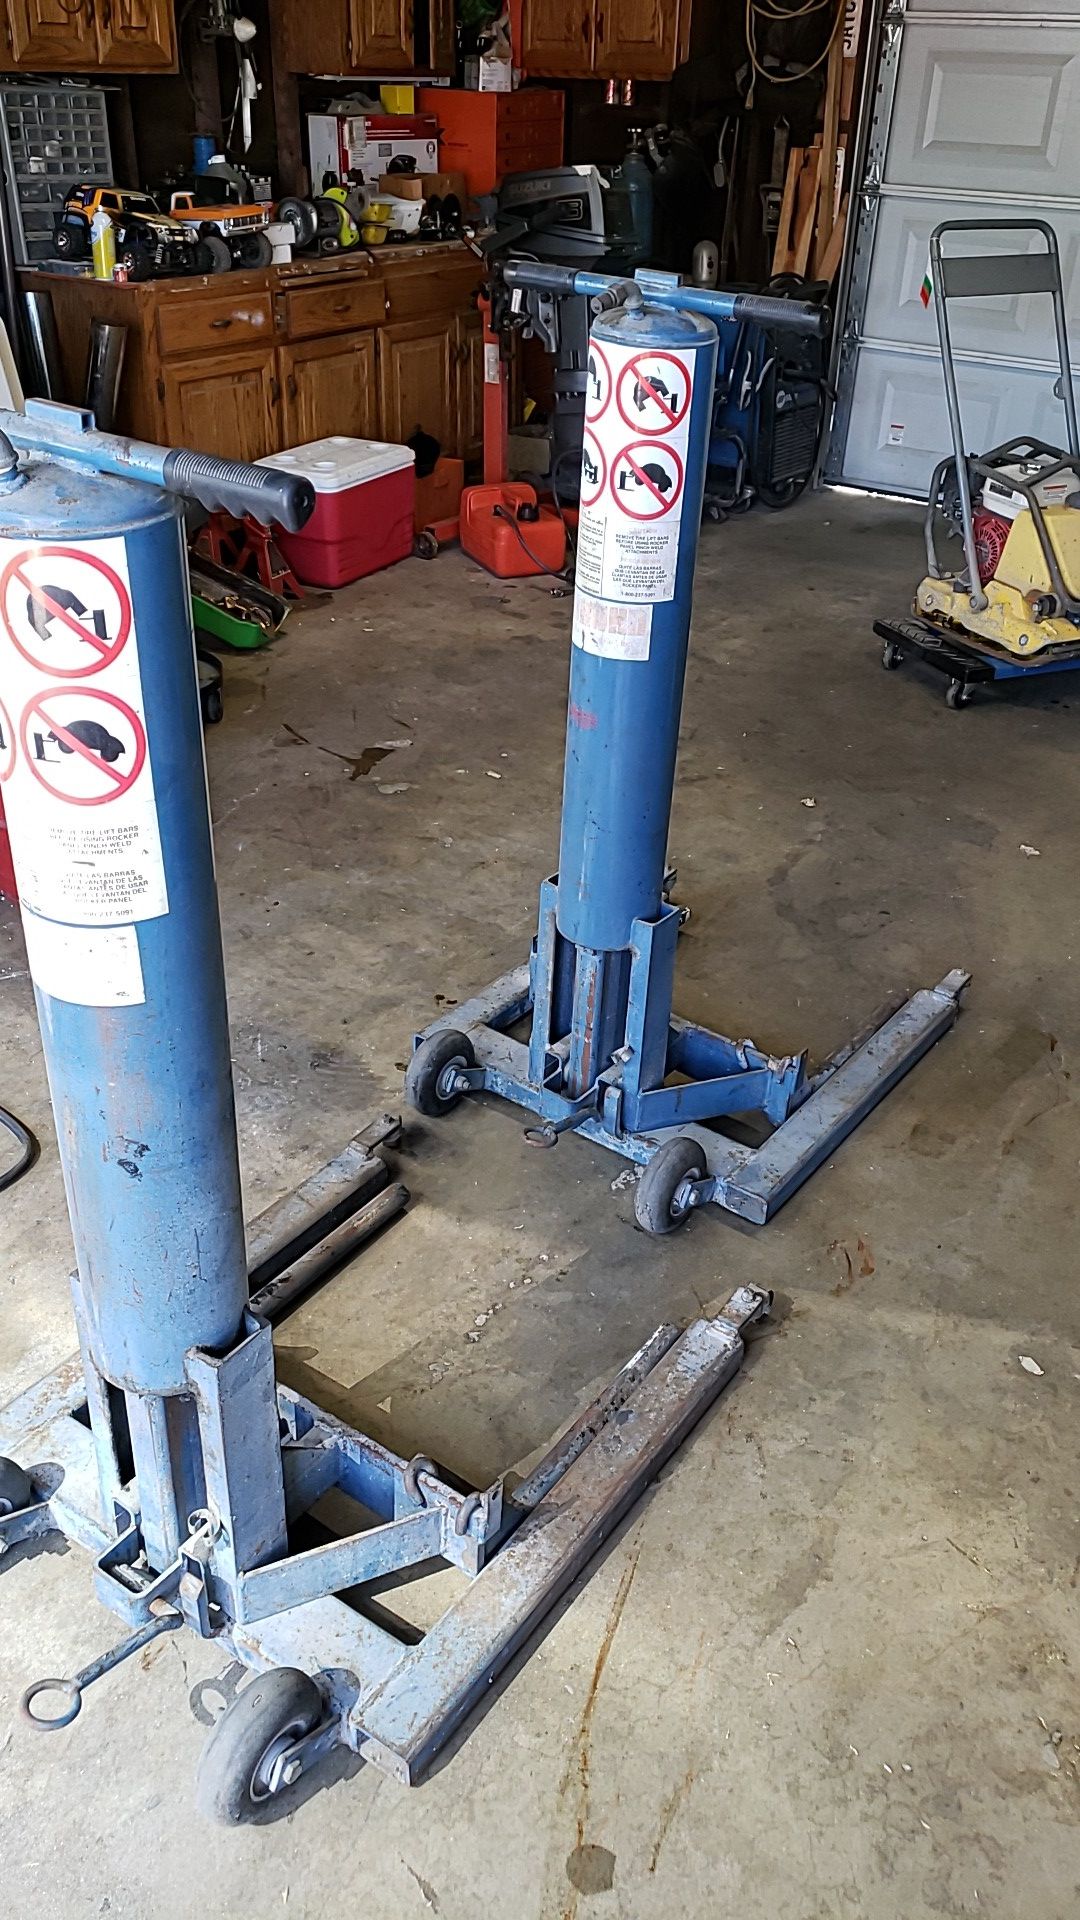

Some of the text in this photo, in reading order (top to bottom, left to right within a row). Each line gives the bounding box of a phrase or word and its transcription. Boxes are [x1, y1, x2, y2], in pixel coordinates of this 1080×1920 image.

[118, 825, 139, 834] BARS
[106, 832, 139, 841] ROCKER
[110, 840, 132, 848] WELD
[104, 869, 136, 878] BARRAS
[128, 874, 143, 883] LAS
[128, 880, 148, 888] USAR
